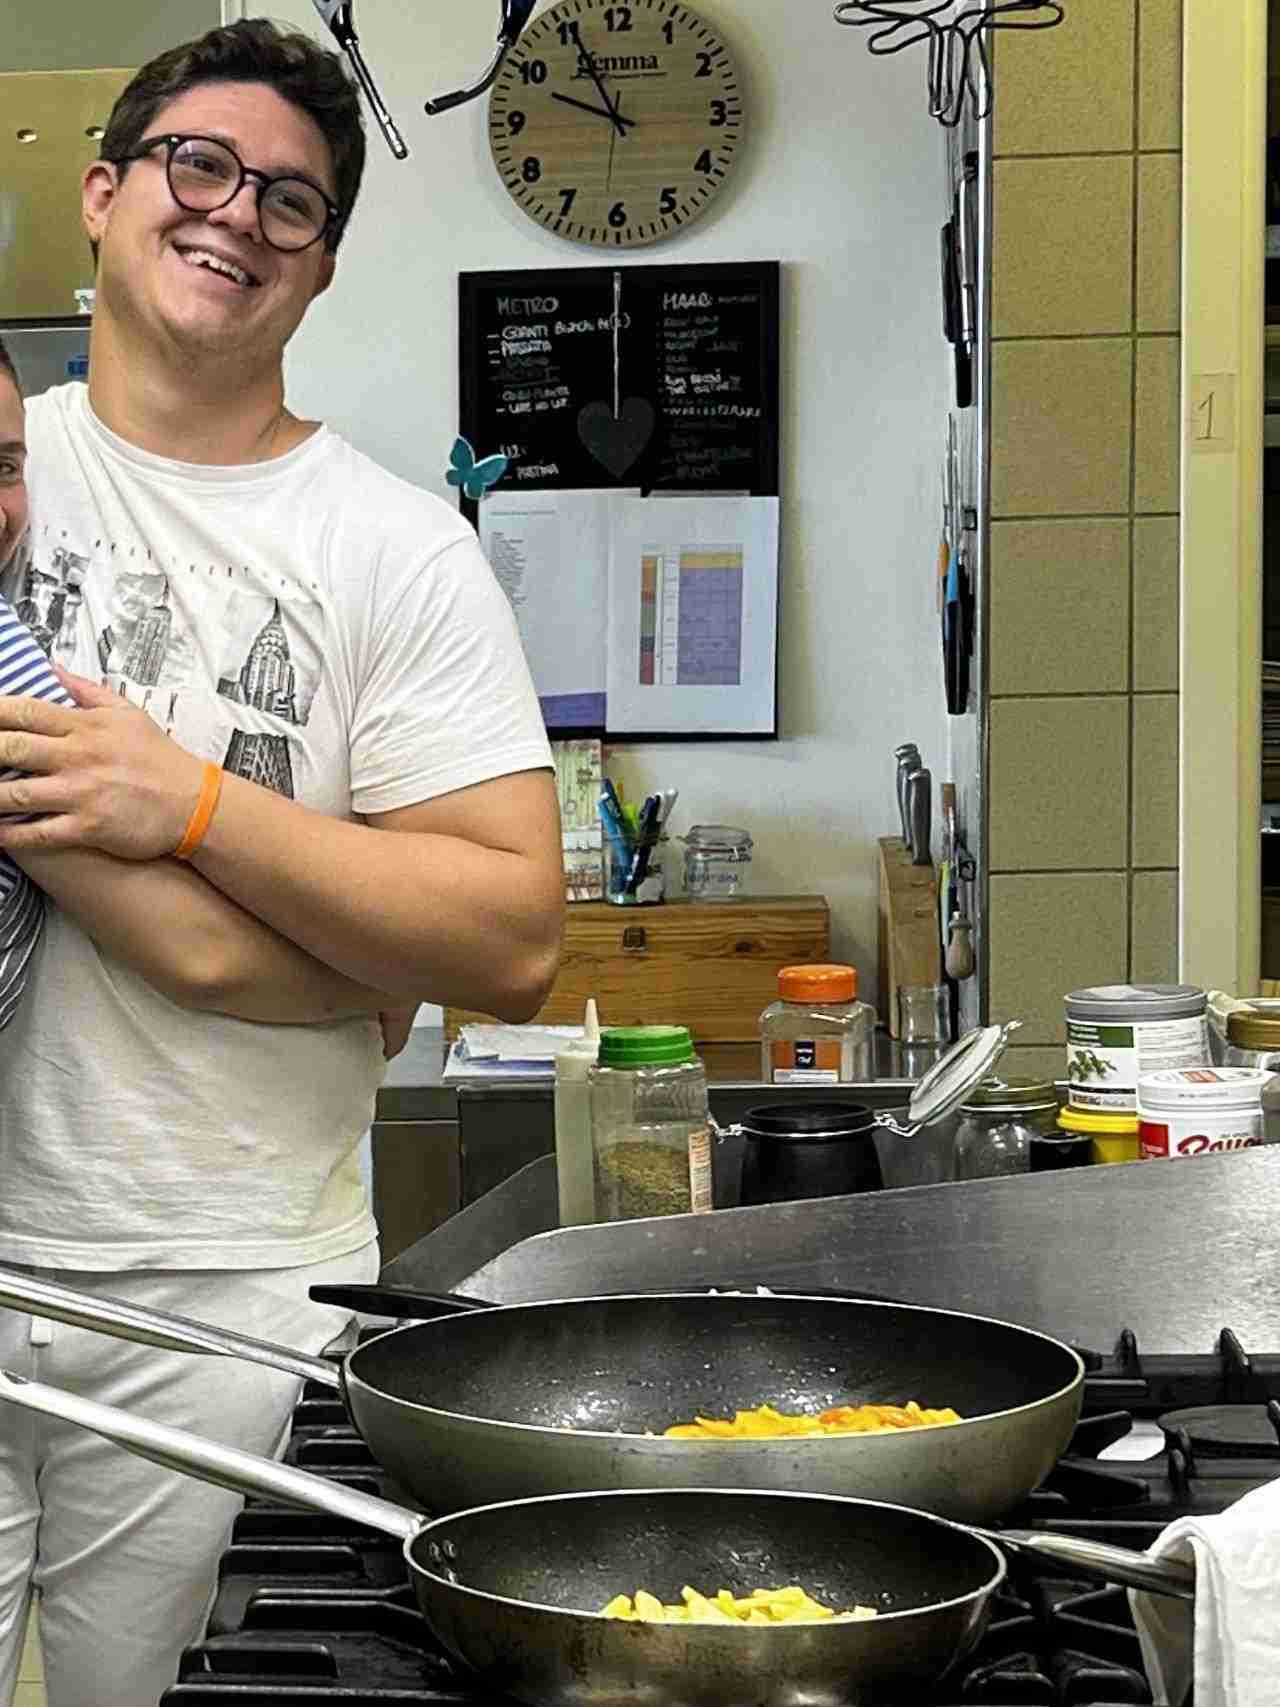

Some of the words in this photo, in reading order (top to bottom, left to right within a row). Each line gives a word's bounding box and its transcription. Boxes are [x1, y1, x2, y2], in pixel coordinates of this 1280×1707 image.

[603, 7, 632, 32] 12
[662, 20, 673, 44] 1
[556, 21, 579, 45] 11
[519, 60, 547, 84] 10
[694, 53, 713, 77] 2
[507, 111, 525, 135] 9
[709, 100, 727, 127] 3
[522, 157, 541, 183] 8
[694, 149, 712, 174] 4
[559, 188, 576, 216] 7
[660, 187, 677, 214] 5
[608, 202, 627, 228] 6
[497, 296, 559, 316] METRO
[1196, 391, 1215, 440] 1
